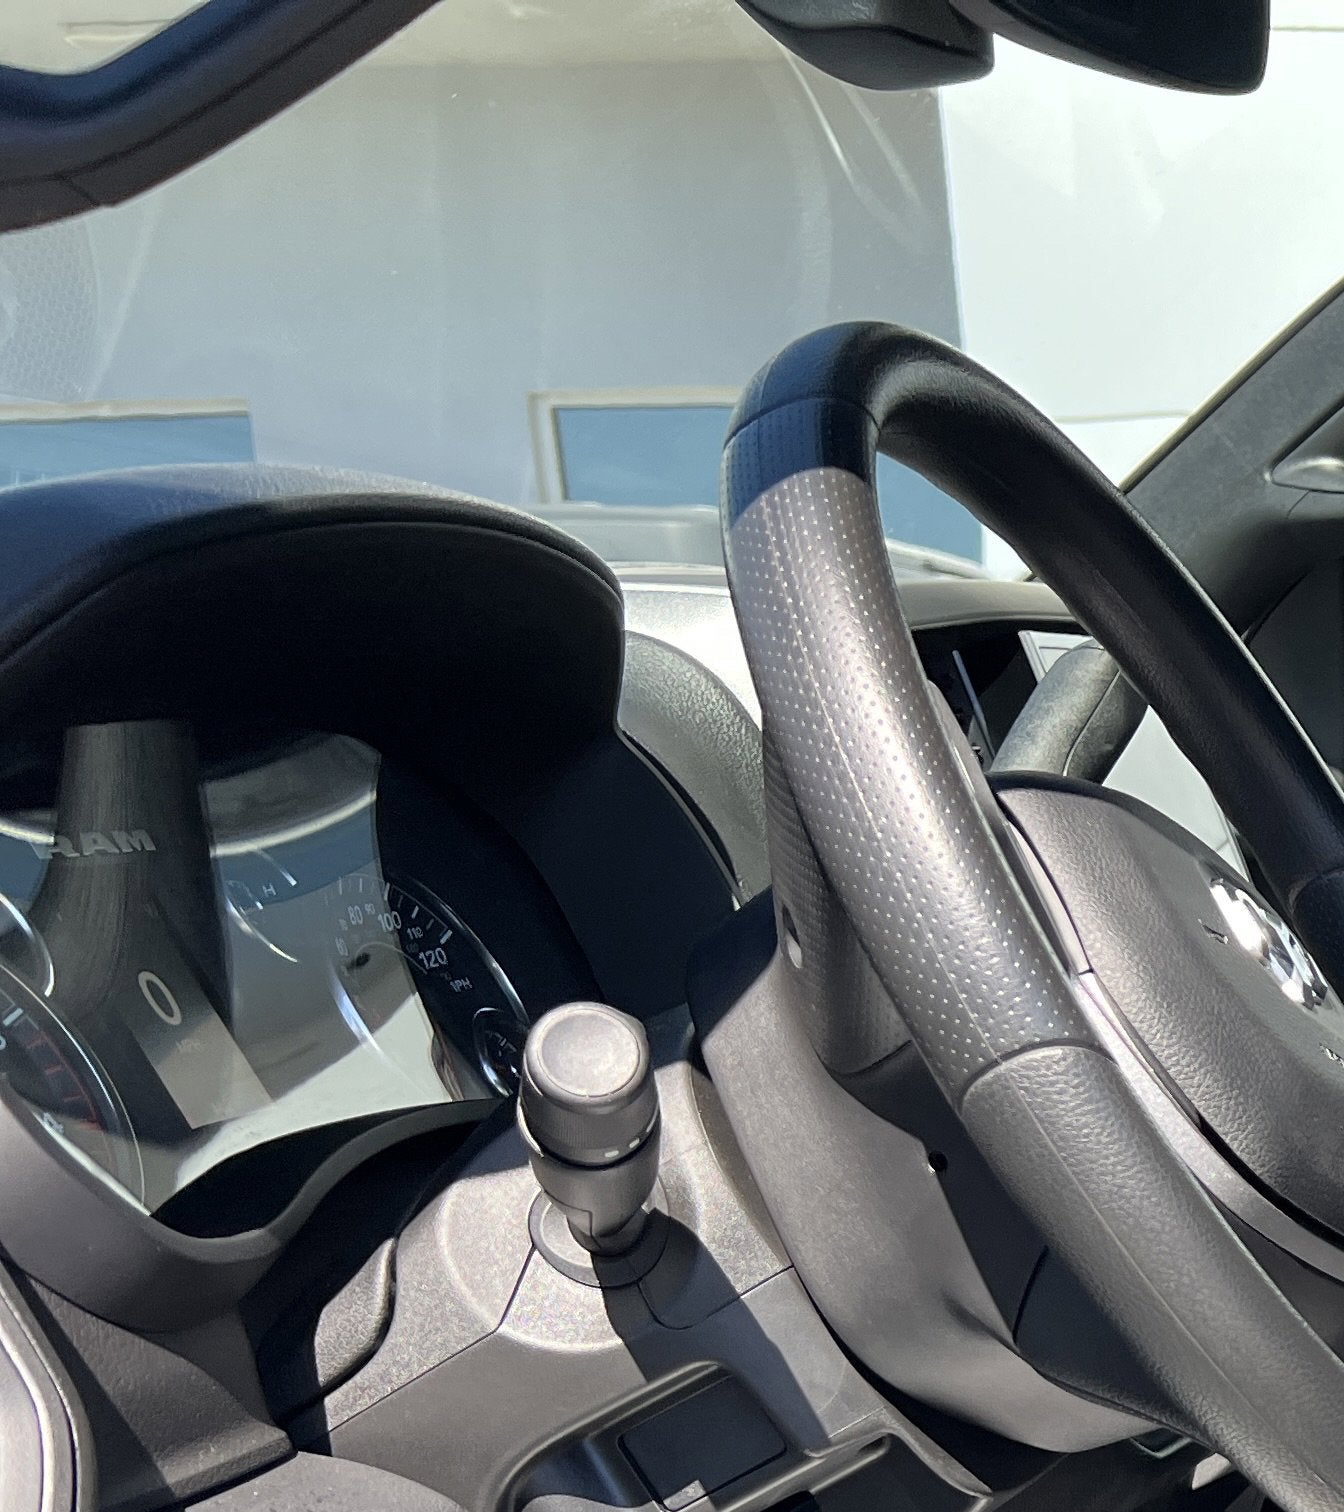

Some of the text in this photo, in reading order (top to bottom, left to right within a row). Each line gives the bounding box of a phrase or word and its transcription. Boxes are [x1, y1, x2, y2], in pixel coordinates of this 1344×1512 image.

[30, 829, 156, 859] RAM
[378, 911, 401, 933] 100
[418, 947, 448, 970] 120
